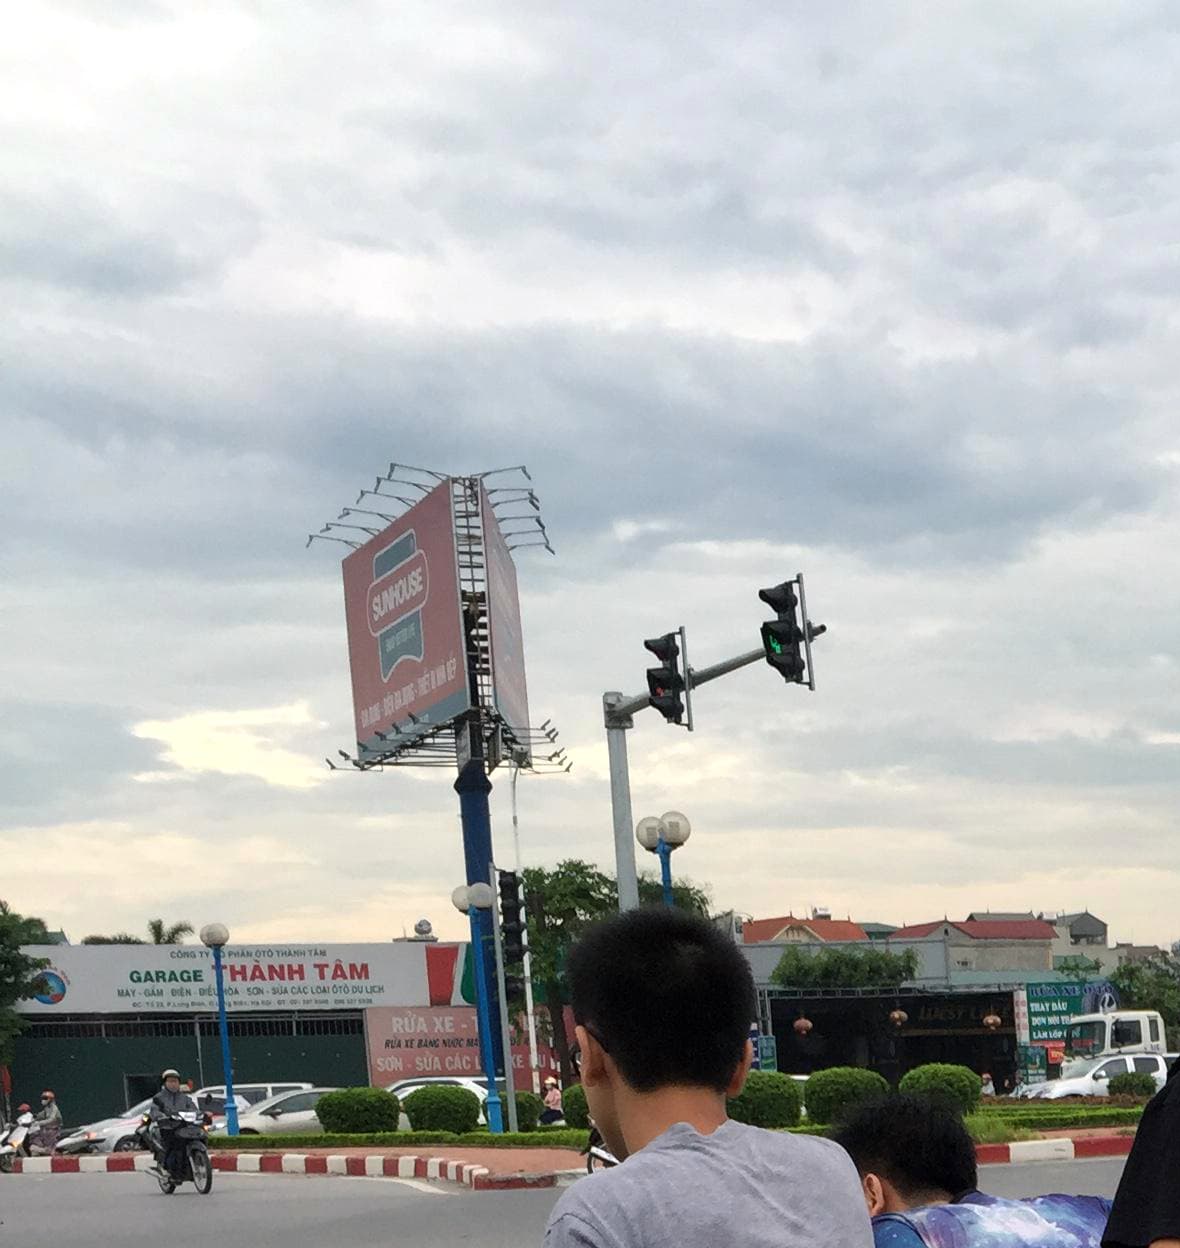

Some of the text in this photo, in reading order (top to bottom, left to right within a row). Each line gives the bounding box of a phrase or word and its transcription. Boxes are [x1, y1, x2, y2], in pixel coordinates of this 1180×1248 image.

[372, 566, 424, 621] SUNHOUSE
[199, 950, 210, 959] TY
[129, 970, 204, 983] GARAGE
[313, 958, 370, 981] TÂM
[1030, 1001, 1050, 1012] THAY
[391, 1011, 429, 1033] RỬA
[434, 1017, 455, 1032] XE
[404, 1039, 415, 1049] XE
[445, 1051, 472, 1070] CÁC
